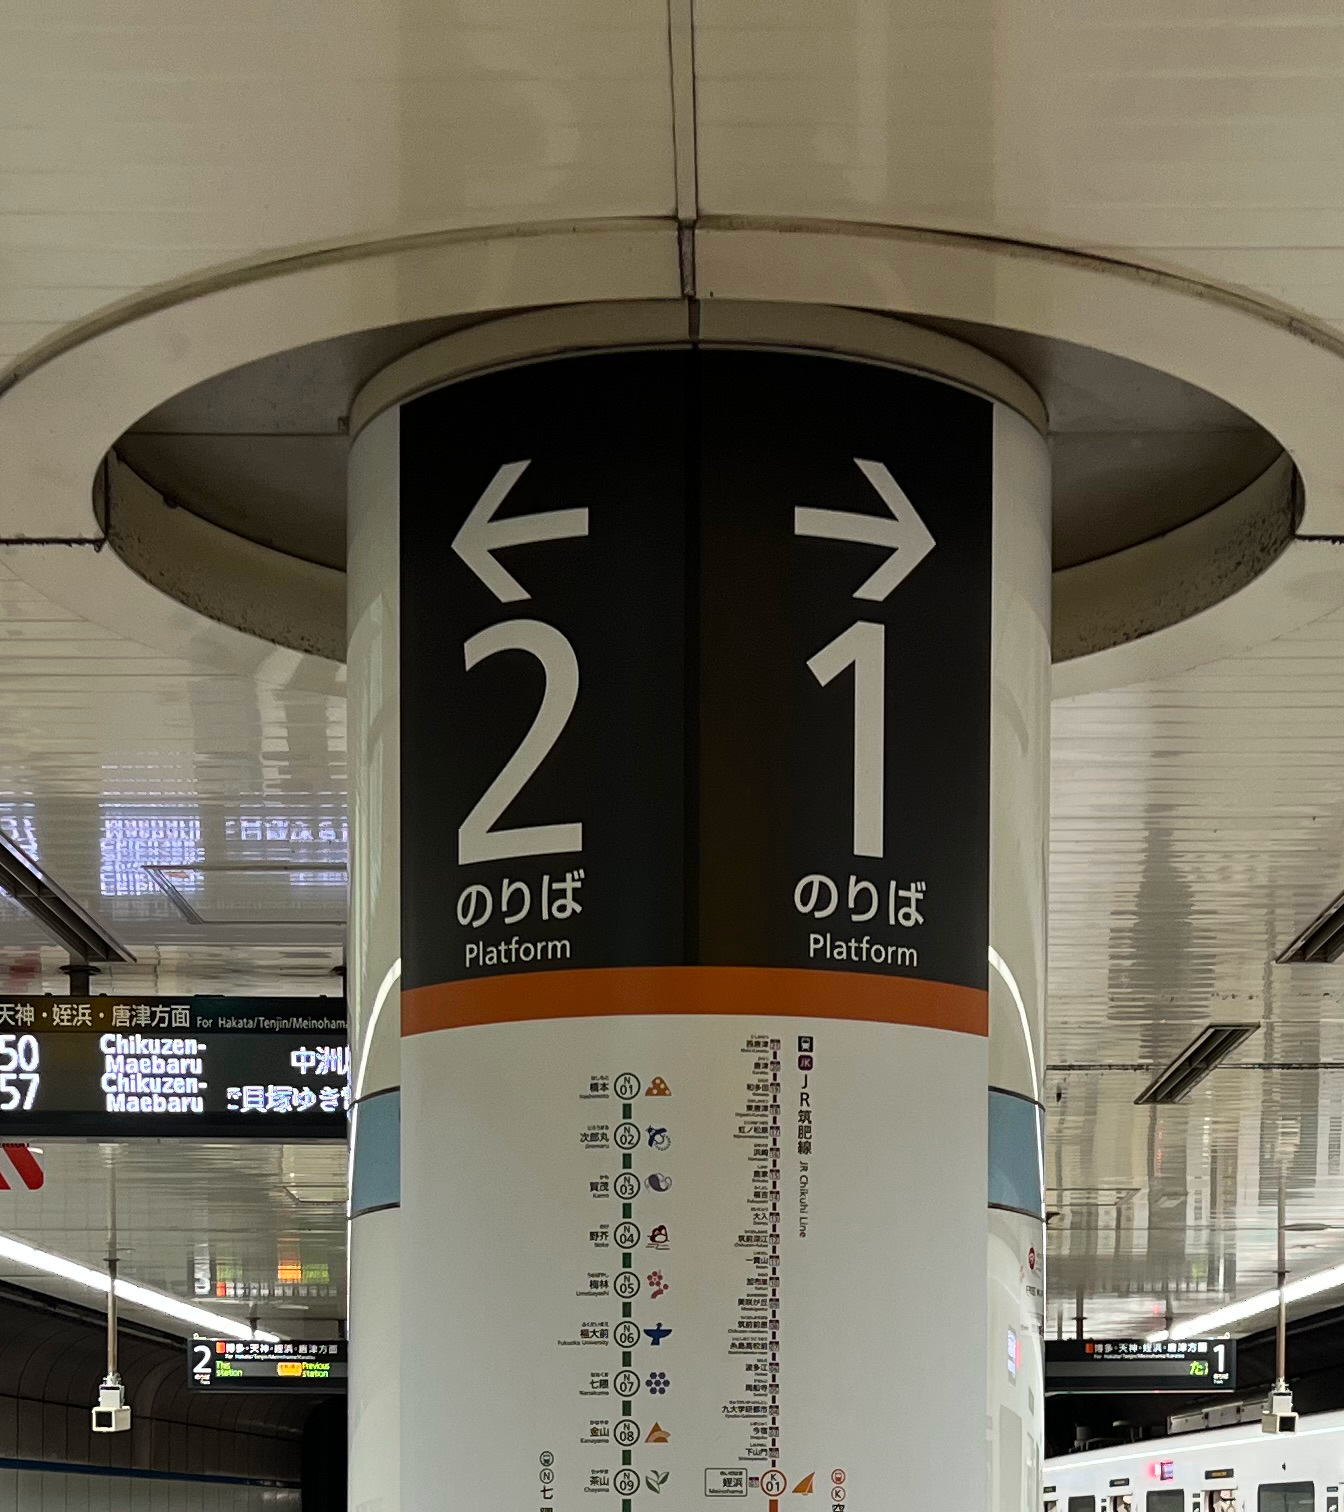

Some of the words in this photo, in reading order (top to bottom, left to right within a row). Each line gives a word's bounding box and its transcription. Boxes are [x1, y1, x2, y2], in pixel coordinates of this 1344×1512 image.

[458, 619, 583, 865] 2
[806, 620, 885, 858] 1
[457, 869, 585, 929] のりば
[794, 874, 926, 928] のりば
[465, 935, 571, 967] Platform
[809, 933, 918, 967] Platform
[196, 1017, 213, 1028] For
[100, 1034, 207, 1055] Chikuzen-
[105, 1055, 203, 1074] Maebaru
[101, 1073, 208, 1093] Chikuzen-
[106, 1093, 204, 1112] Maebaru
[797, 1074, 812, 1155] JR筑肥線
[799, 1160, 809, 1172] JR
[799, 1175, 809, 1214] Chikuhi
[799, 1216, 808, 1238] Line
[193, 1344, 212, 1373] 2
[216, 1361, 230, 1370] This
[303, 1361, 330, 1370] Previous
[1213, 1344, 1225, 1373] 1
[216, 1369, 243, 1378] station
[303, 1369, 328, 1378] station
[590, 1427, 609, 1437] 金山
[590, 1476, 609, 1486] 茶山
[766, 1482, 781, 1492] 01
